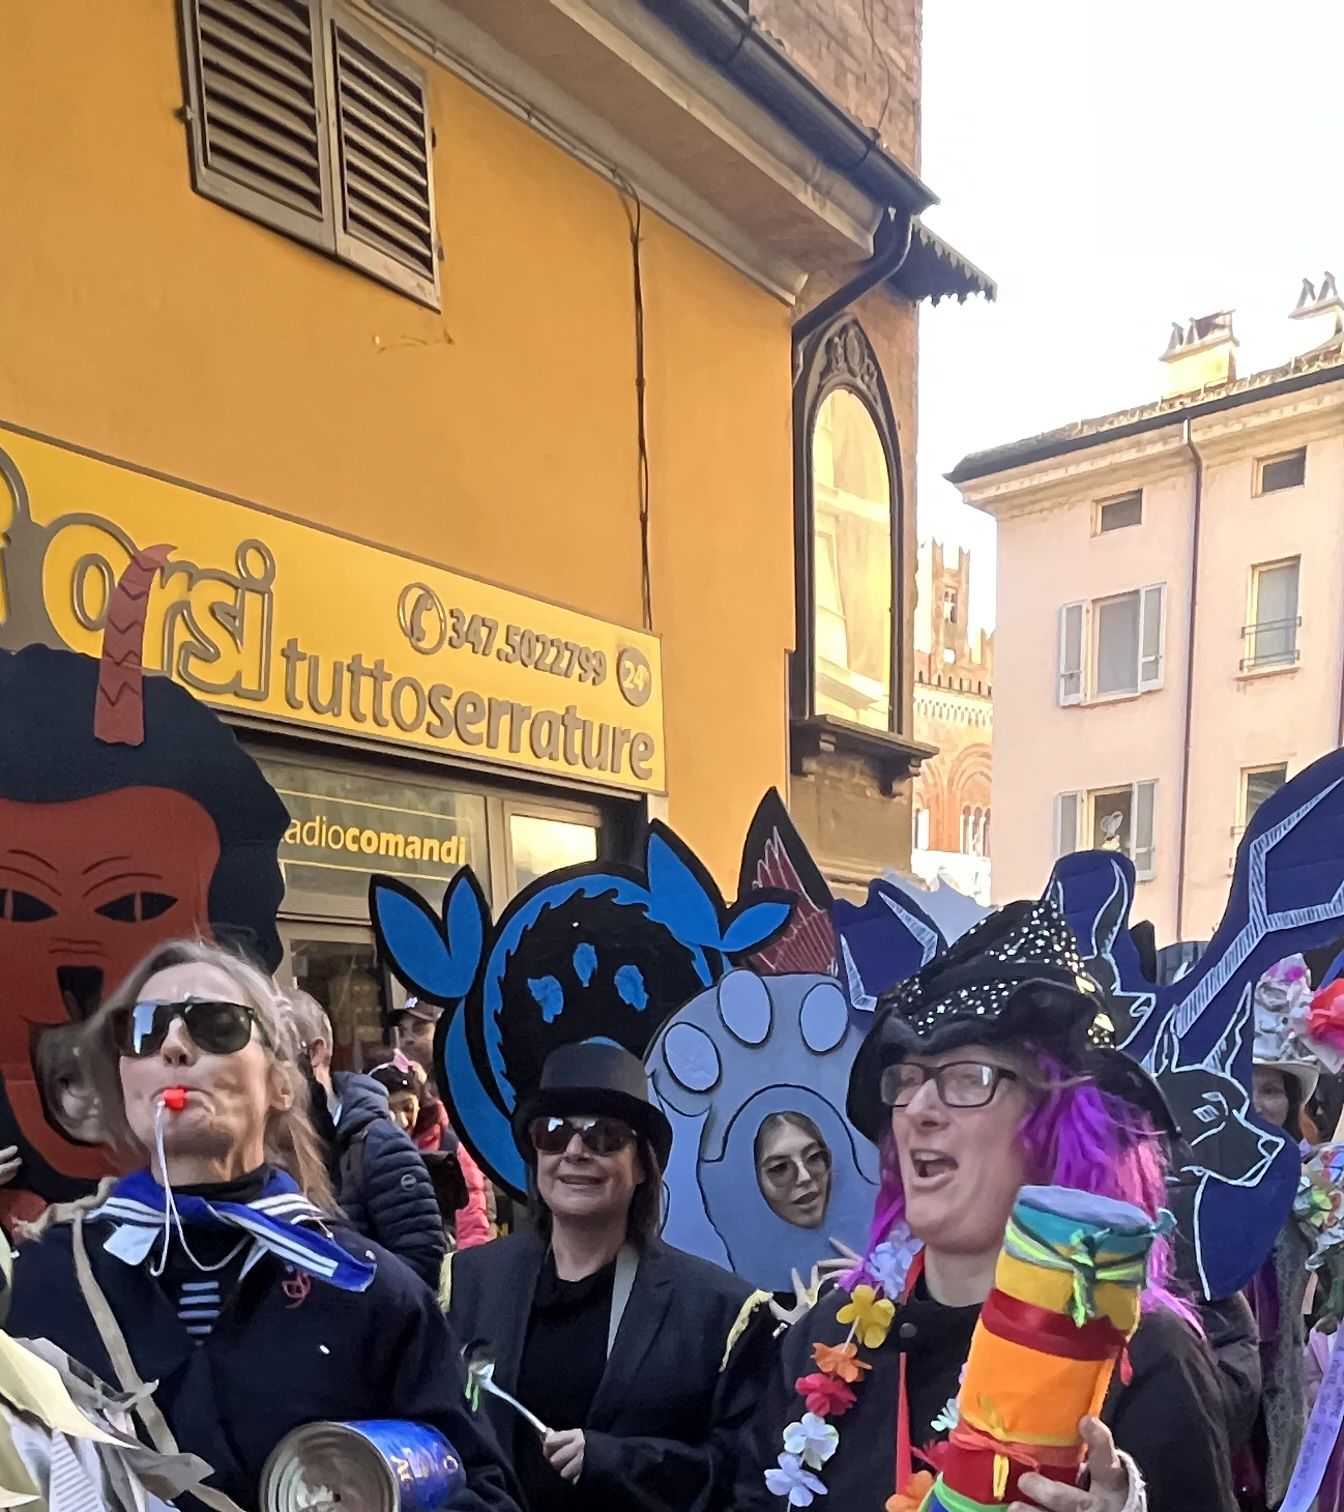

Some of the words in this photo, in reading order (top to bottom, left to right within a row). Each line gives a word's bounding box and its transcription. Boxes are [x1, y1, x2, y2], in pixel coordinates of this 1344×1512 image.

[447, 606, 608, 687] 347.5022799
[282, 637, 655, 781] tuttoserrature
[281, 815, 466, 866] adiocomandi
